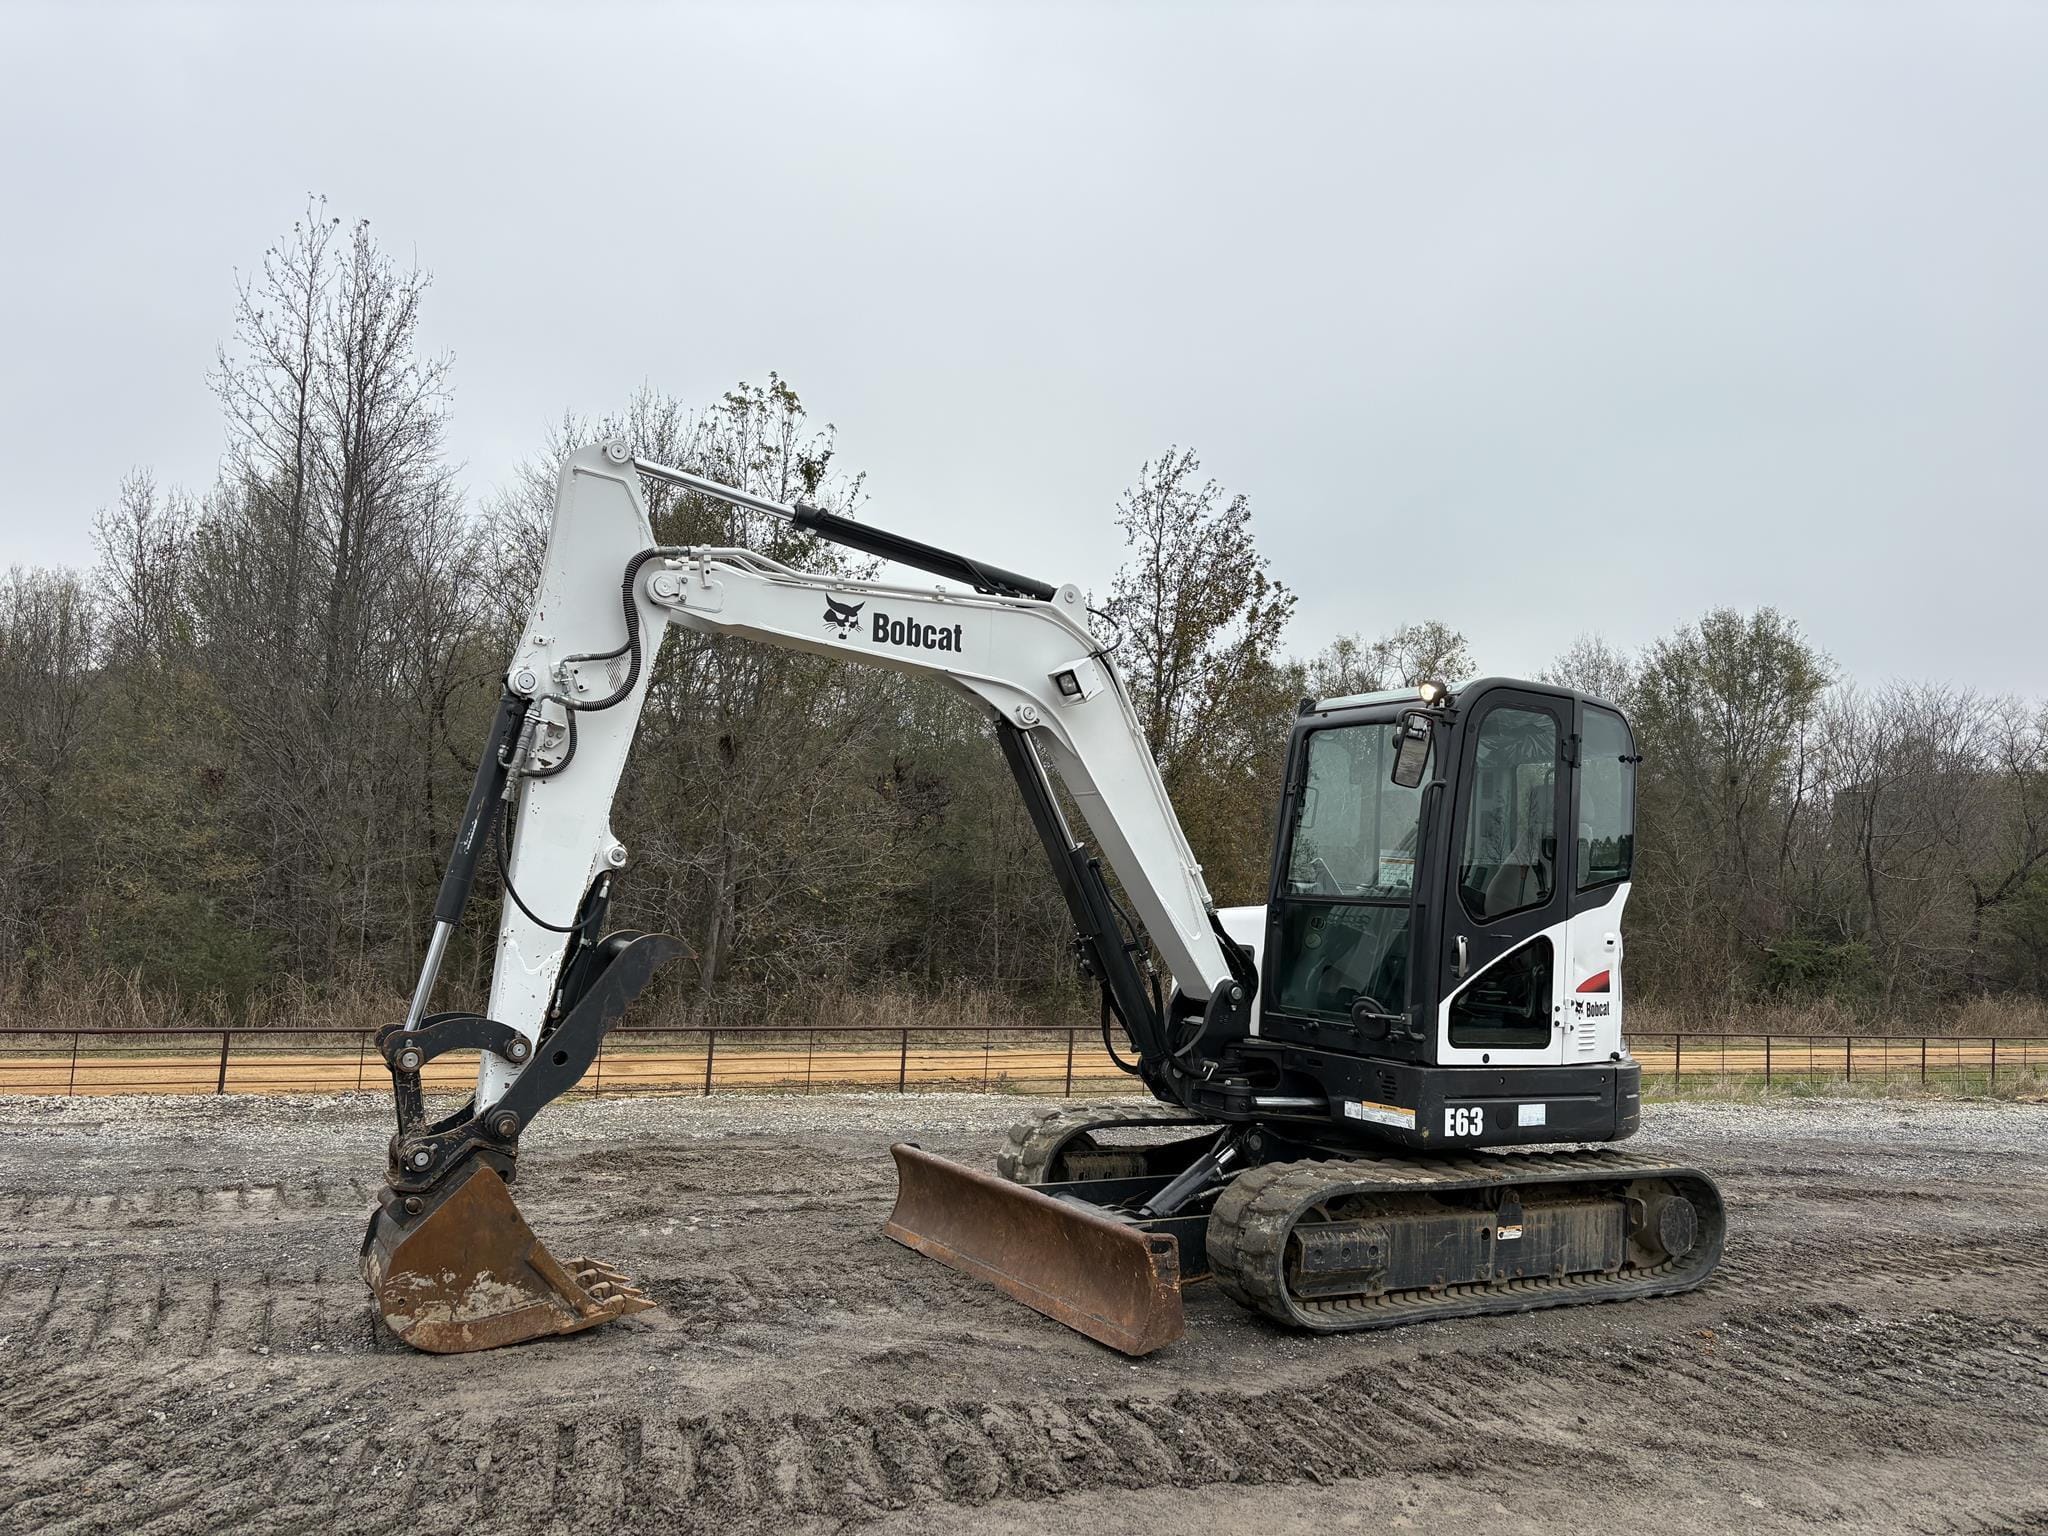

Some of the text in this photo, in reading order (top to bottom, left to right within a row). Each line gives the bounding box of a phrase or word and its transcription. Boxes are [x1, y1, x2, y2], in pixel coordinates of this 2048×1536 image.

[872, 612, 962, 653] Bobcat
[1586, 1001, 1610, 1018] Bobcat
[1444, 1107, 1484, 1137] E63
